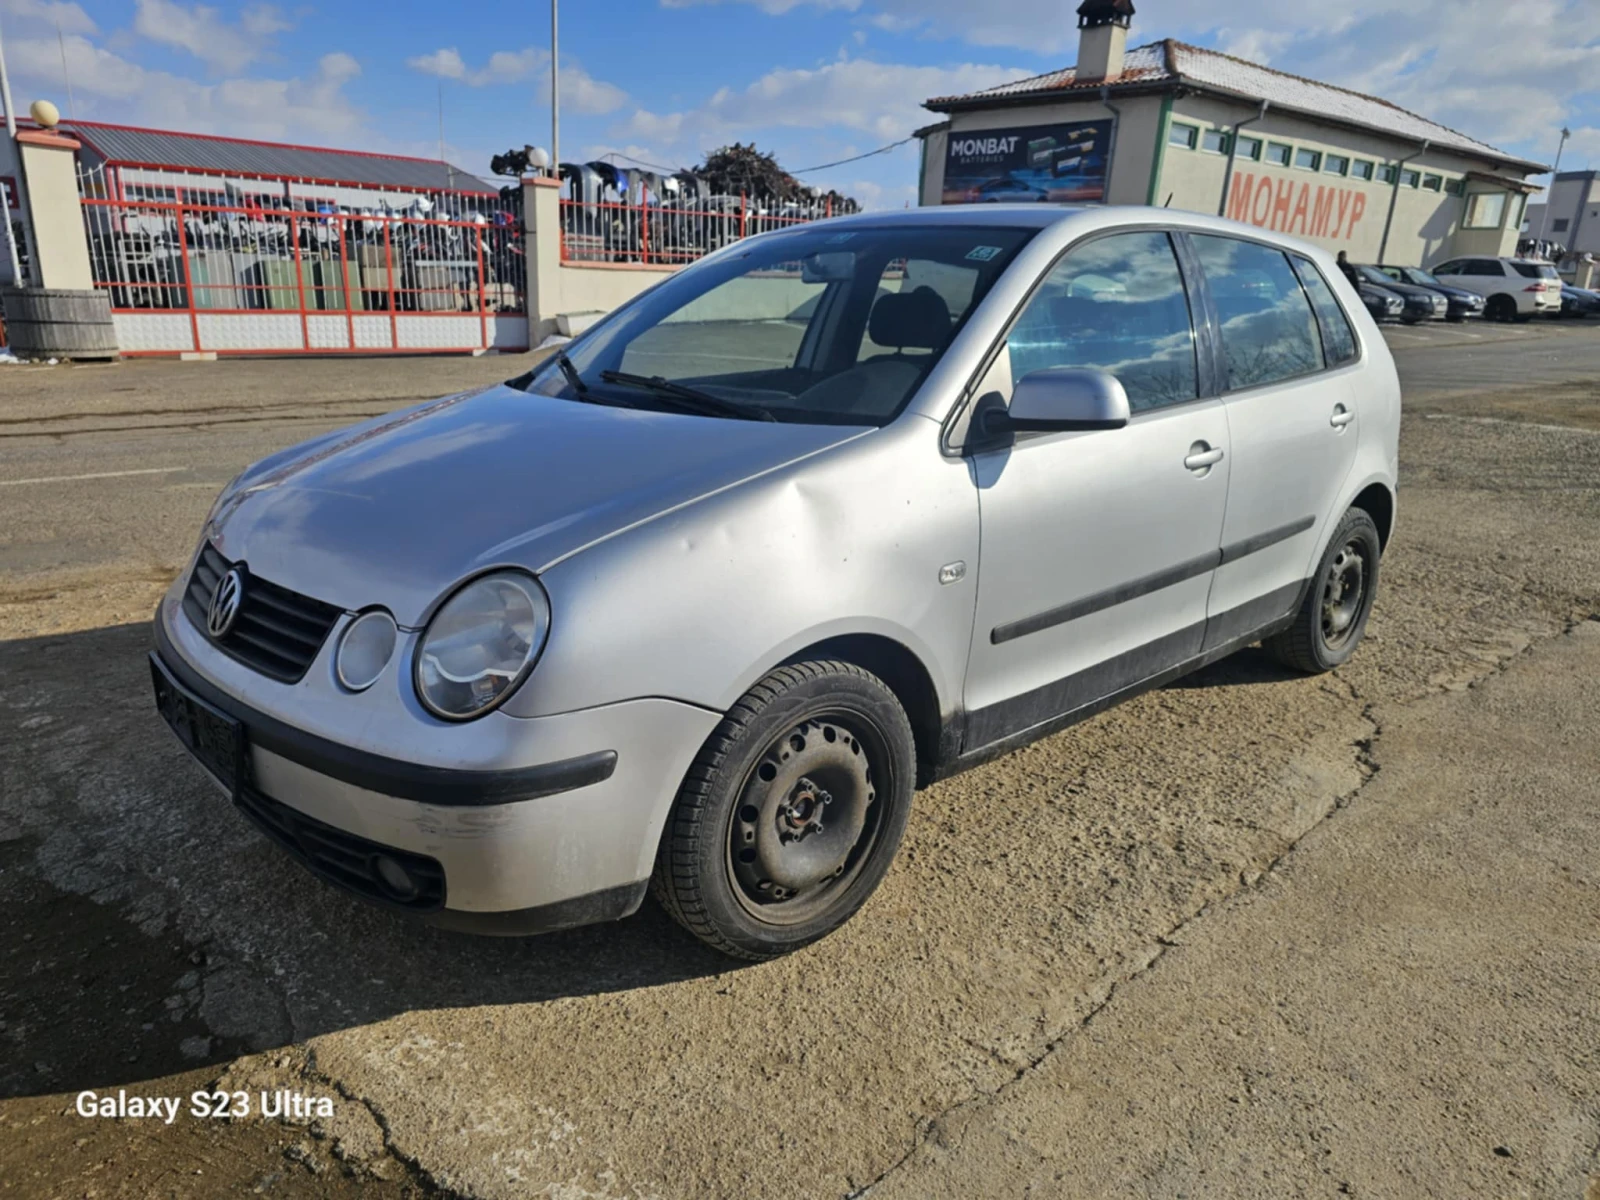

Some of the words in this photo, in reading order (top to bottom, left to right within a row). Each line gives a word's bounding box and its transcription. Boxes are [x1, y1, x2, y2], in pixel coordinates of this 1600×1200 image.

[951, 136, 1019, 157] MONBAT
[960, 155, 1004, 164] BATTERIES
[1227, 171, 1366, 240] МОНАМУР
